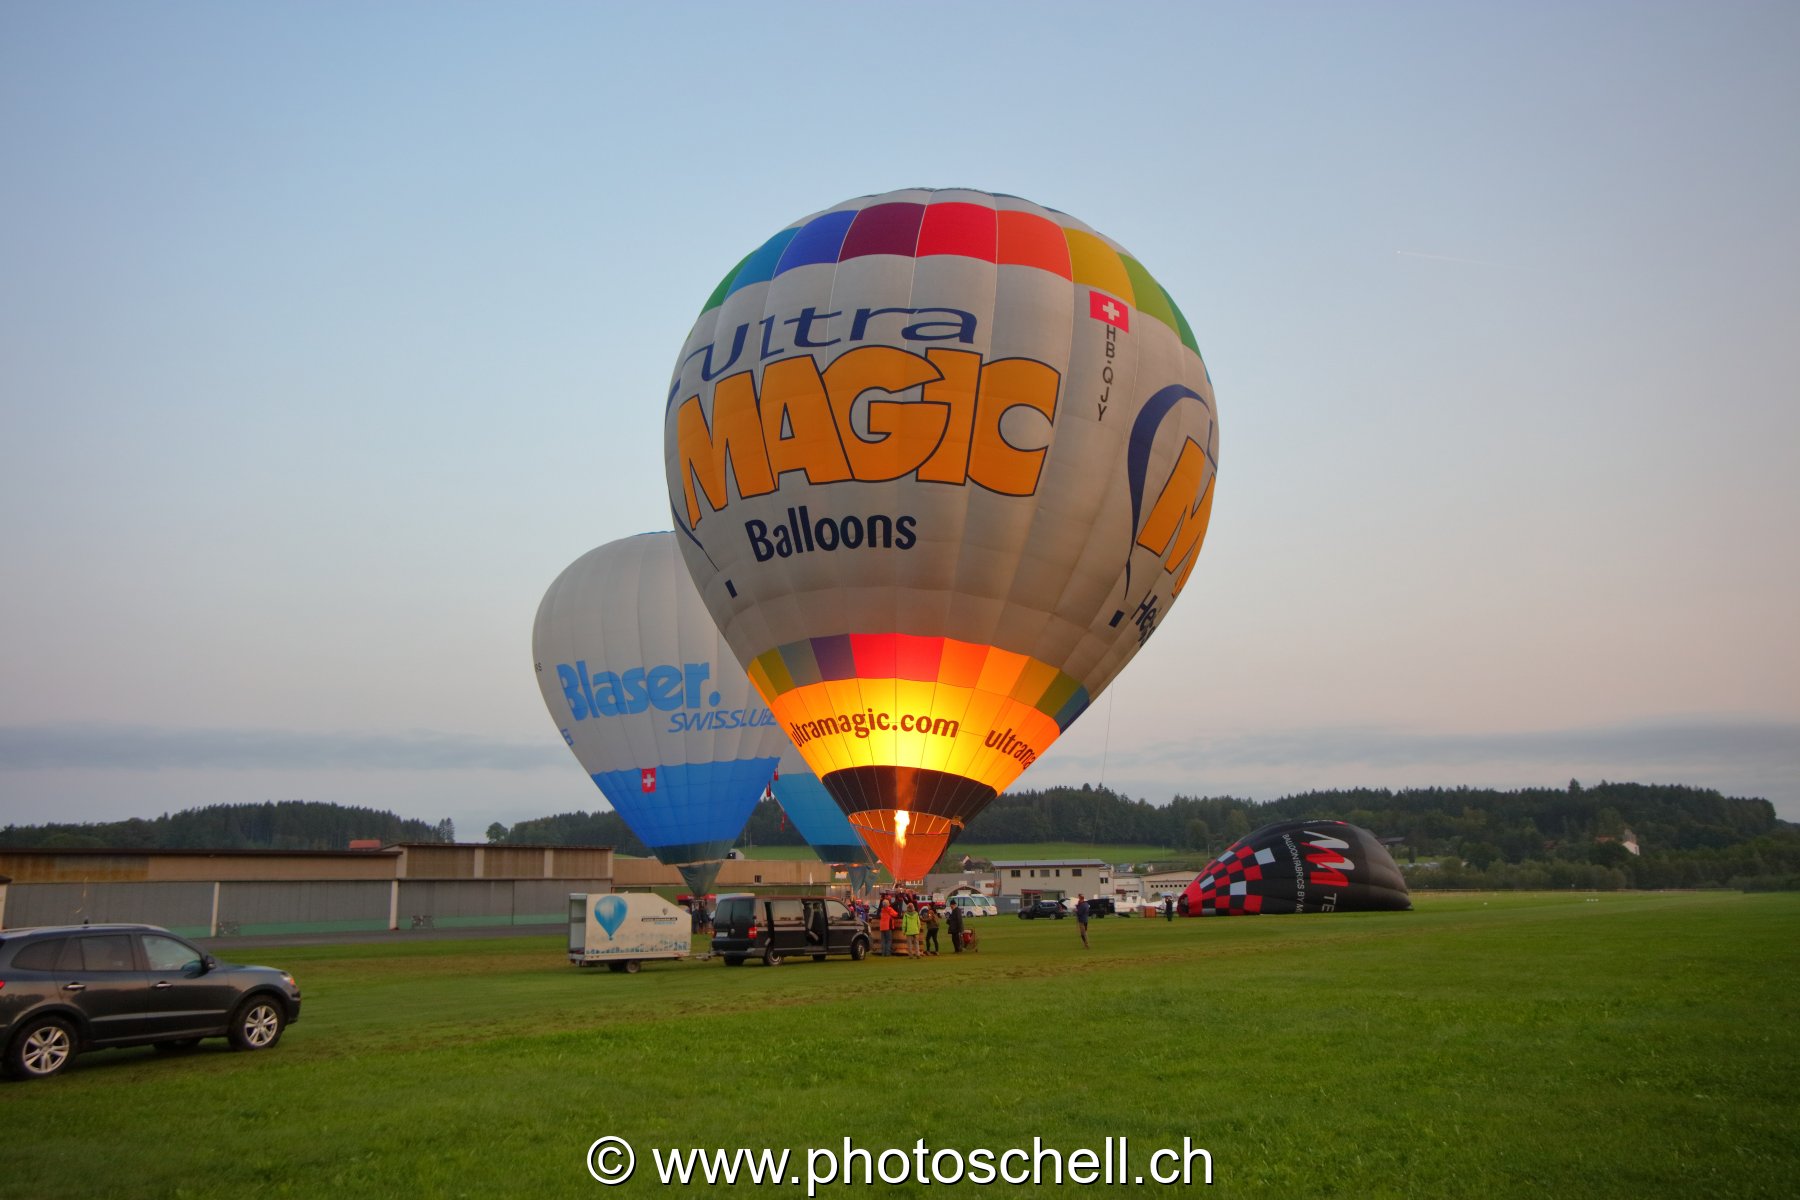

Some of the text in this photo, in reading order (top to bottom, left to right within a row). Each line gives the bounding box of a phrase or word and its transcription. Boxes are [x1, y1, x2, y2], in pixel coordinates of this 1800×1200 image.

[701, 307, 977, 382] ultra
[677, 344, 1061, 531] MAGIC
[745, 505, 917, 562] Balloons
[556, 660, 721, 721] Blaser.
[790, 708, 959, 747] ultramagic.com
[1282, 833, 1299, 860] BALLOON
